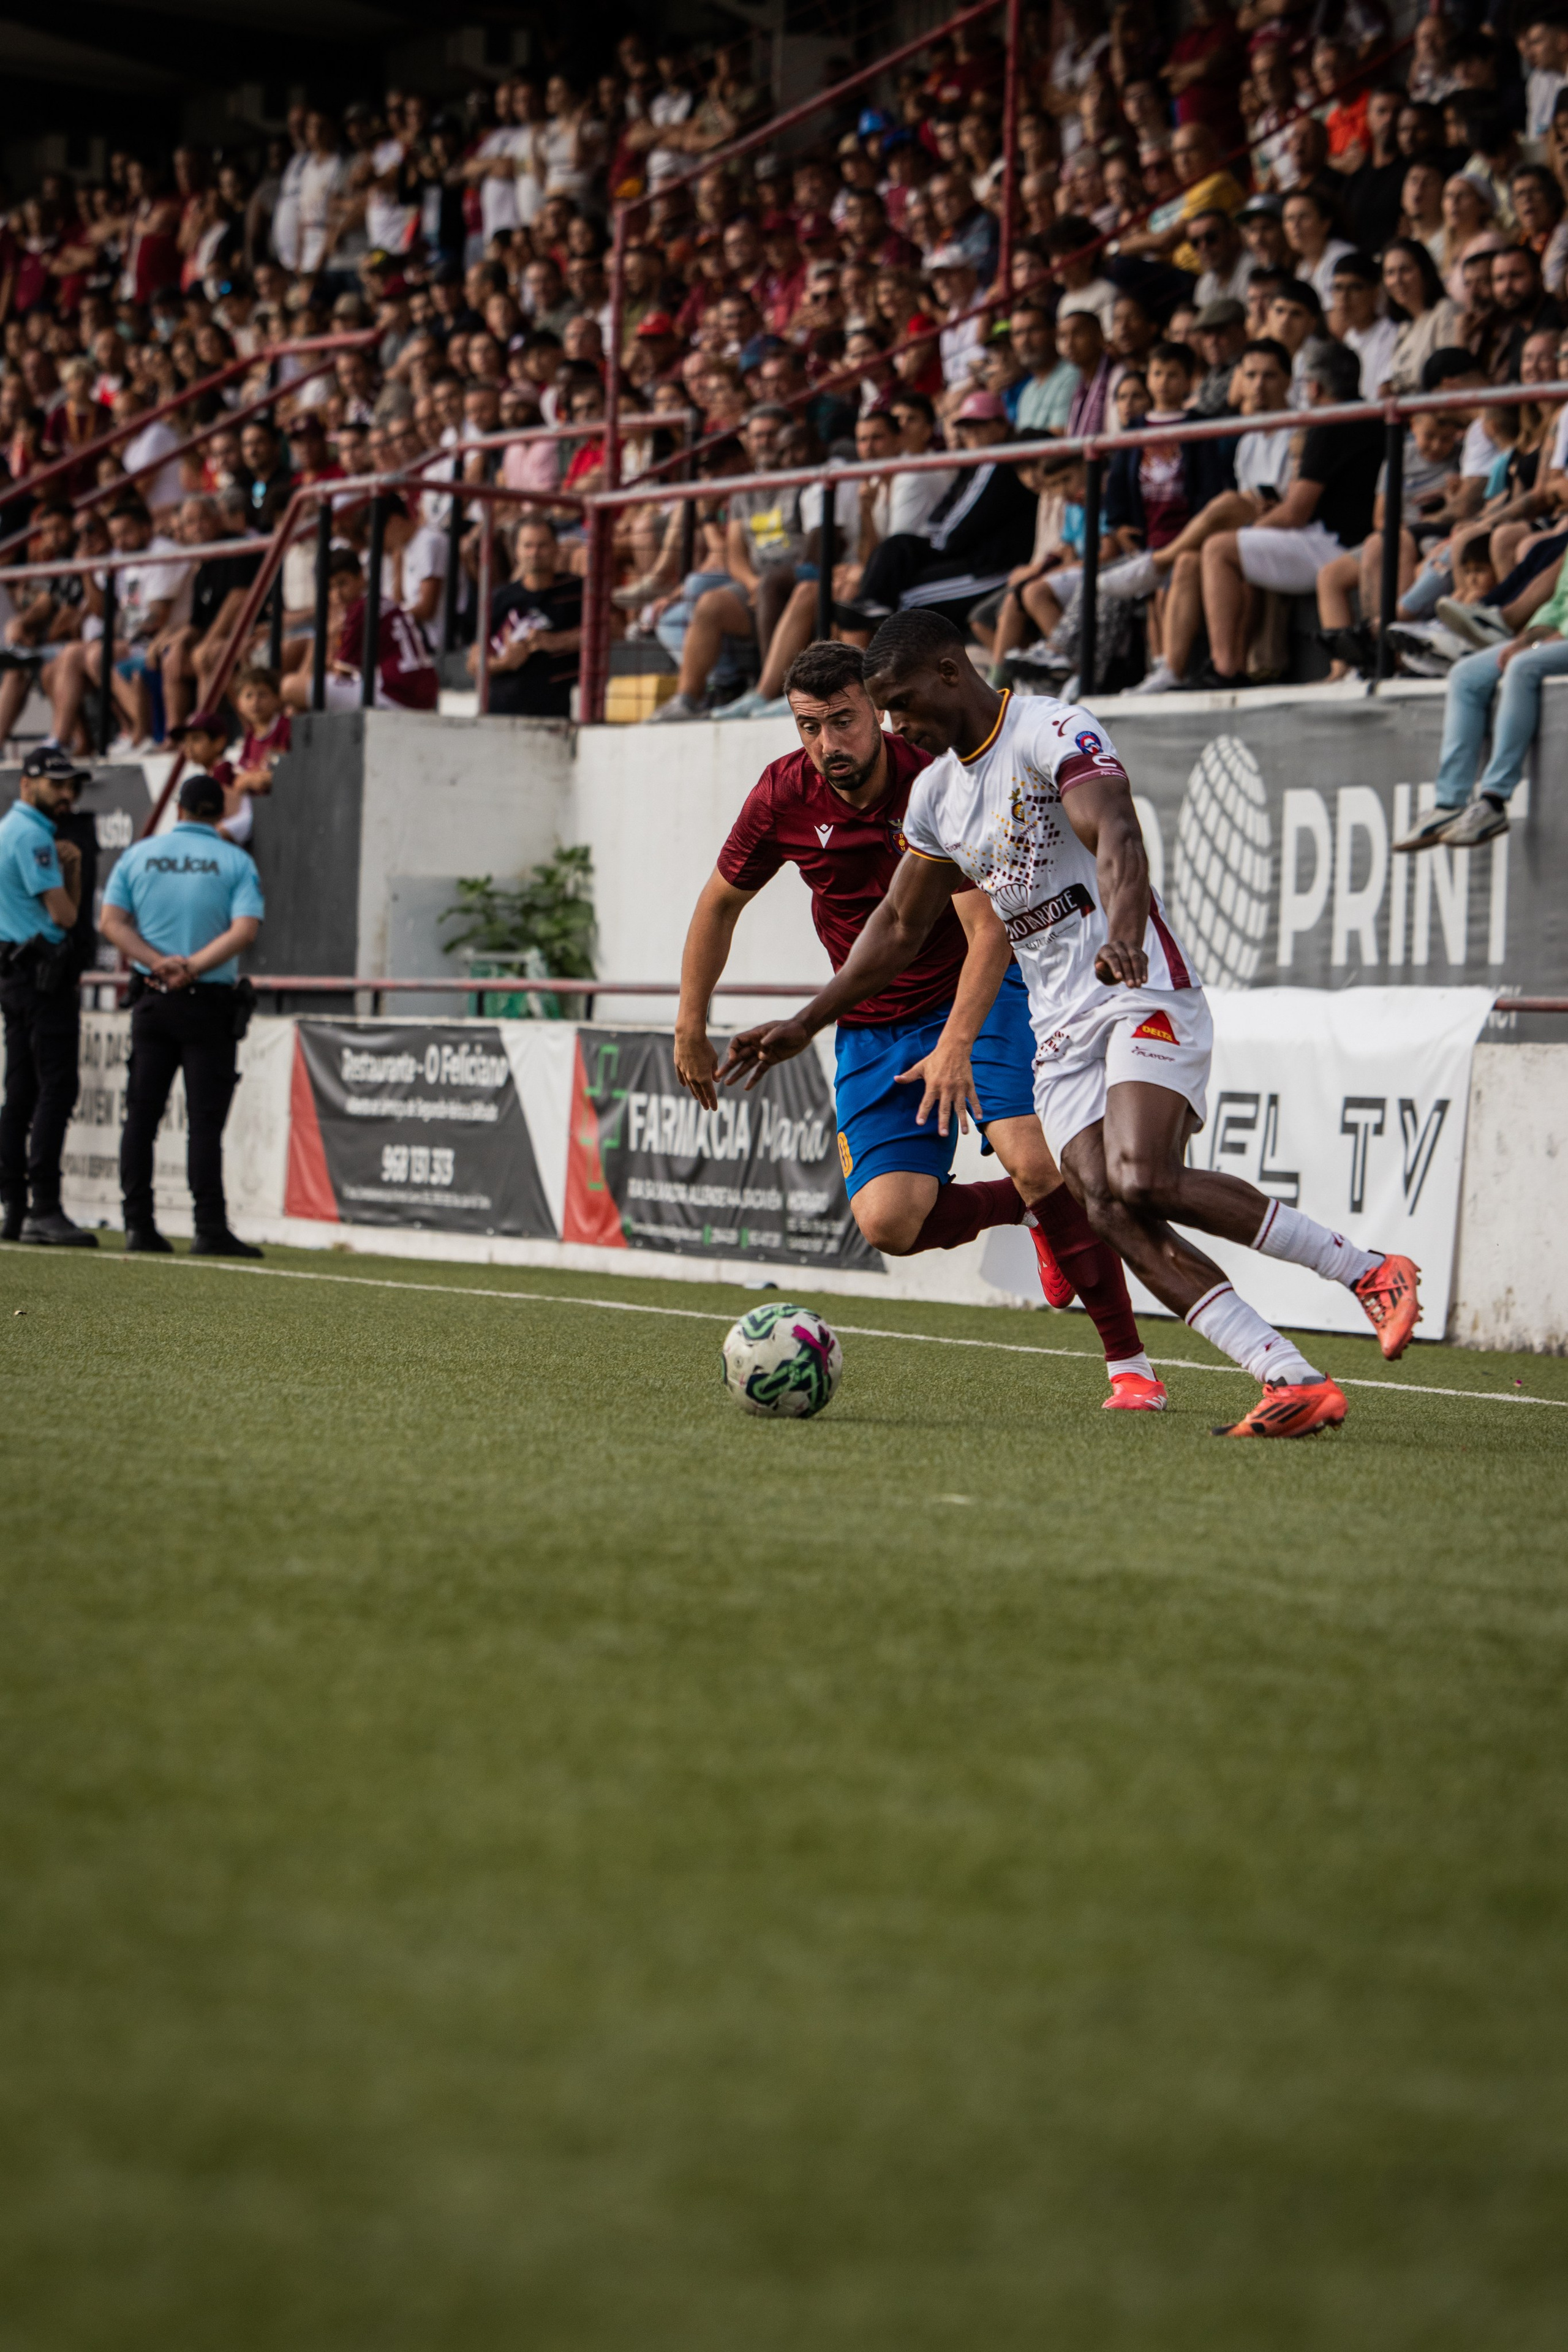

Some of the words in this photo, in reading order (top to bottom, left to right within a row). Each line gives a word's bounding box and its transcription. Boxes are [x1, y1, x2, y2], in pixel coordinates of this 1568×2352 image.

[145, 853, 221, 877] POLÍCIA
[1276, 778, 1529, 967] PRINT
[1142, 1025, 1173, 1041] DELTA
[424, 1043, 440, 1085] O
[440, 1042, 509, 1087] Feliciano
[1340, 1096, 1452, 1216] TV
